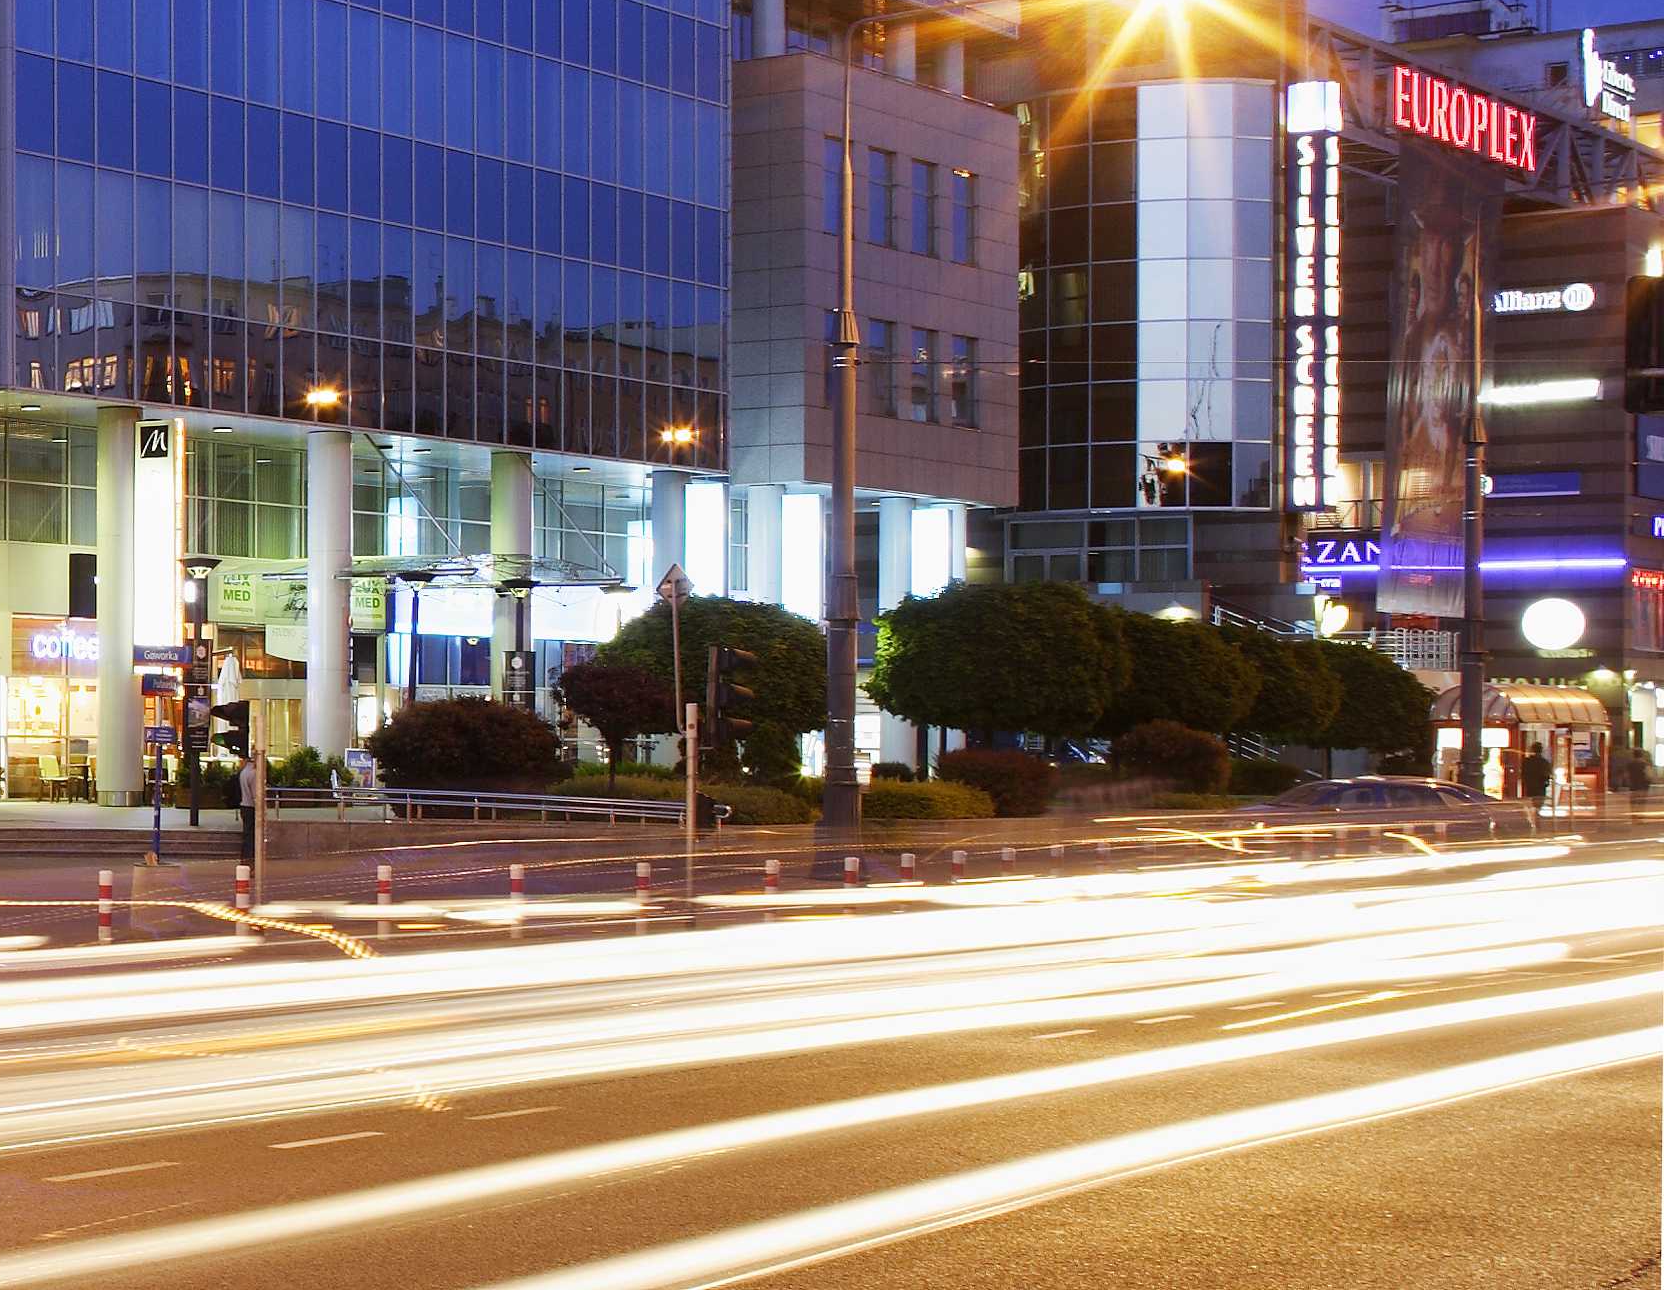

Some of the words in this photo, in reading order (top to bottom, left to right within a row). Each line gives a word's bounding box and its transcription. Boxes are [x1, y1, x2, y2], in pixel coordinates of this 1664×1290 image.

[1392, 64, 1537, 172] EUROPLEX
[223, 589, 251, 602] MED
[354, 597, 381, 609] MED
[143, 650, 179, 661] Goworka
